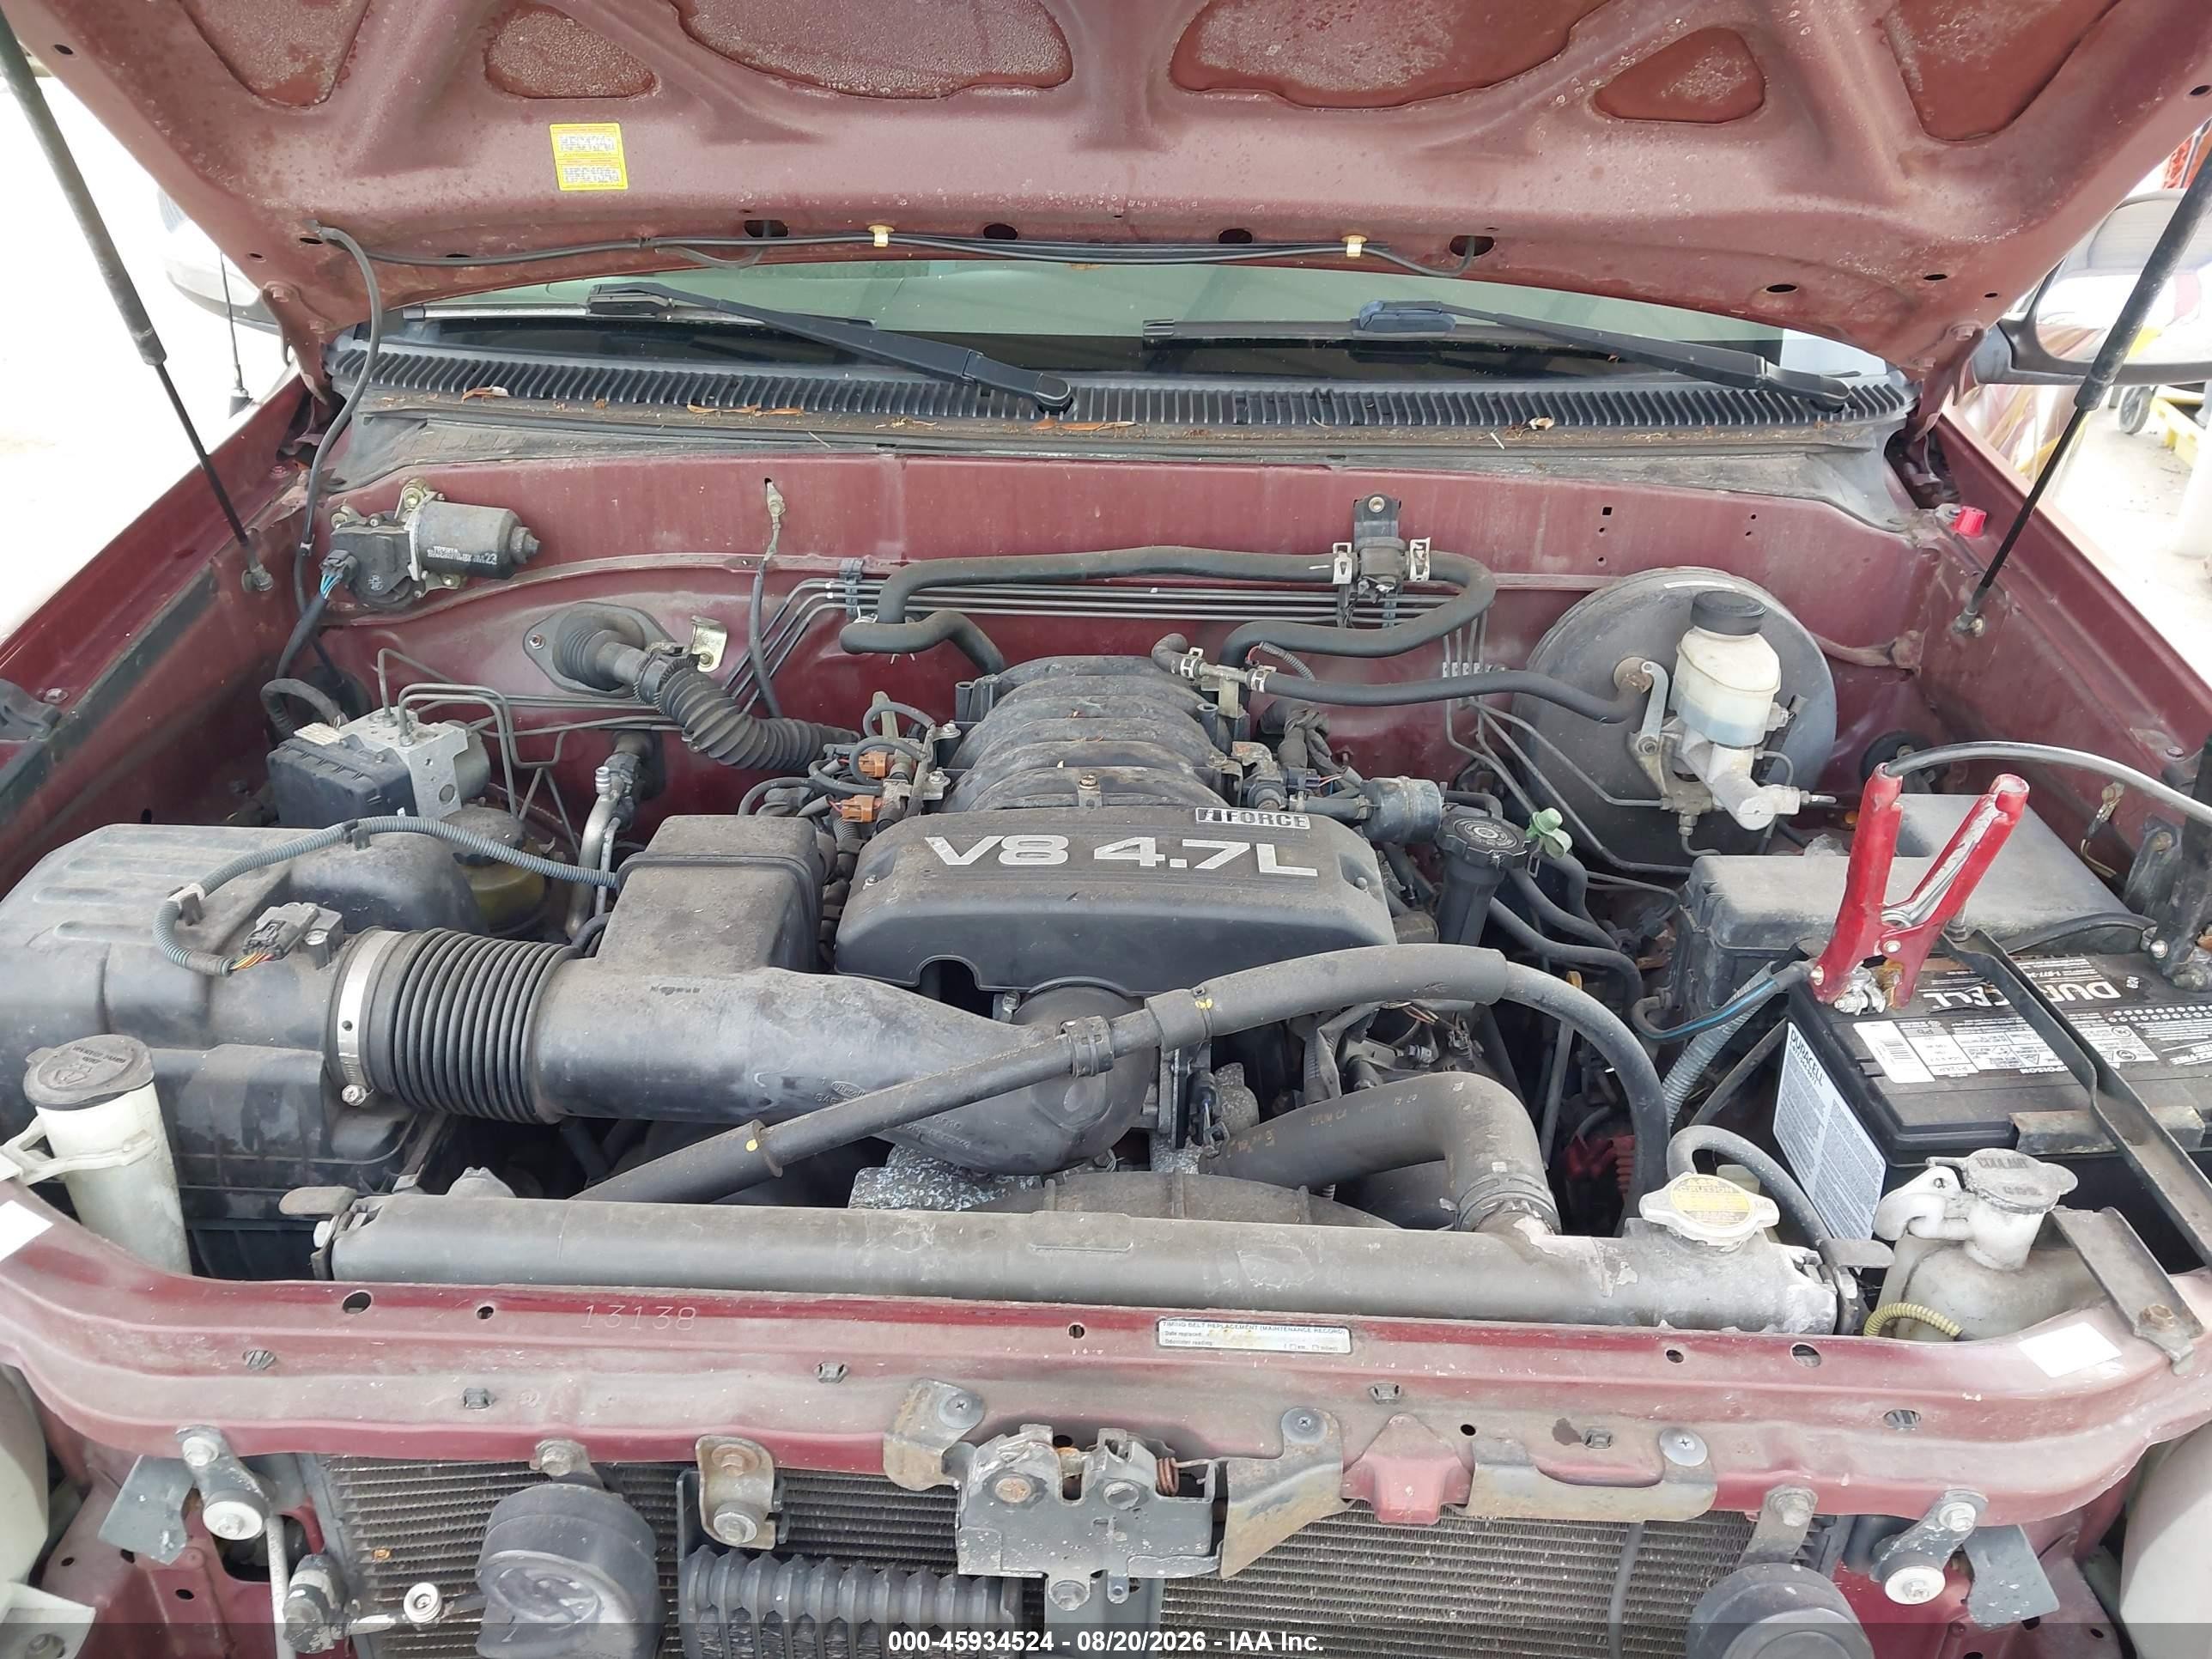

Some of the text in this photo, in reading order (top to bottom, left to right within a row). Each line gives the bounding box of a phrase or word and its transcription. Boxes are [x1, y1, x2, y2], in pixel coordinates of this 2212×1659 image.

[924, 834, 1318, 878] V8 4.7L
[1923, 980, 2123, 1008] DURCELL
[1790, 1030, 1826, 1086] DURACELL
[580, 1304, 697, 1331] 13138
